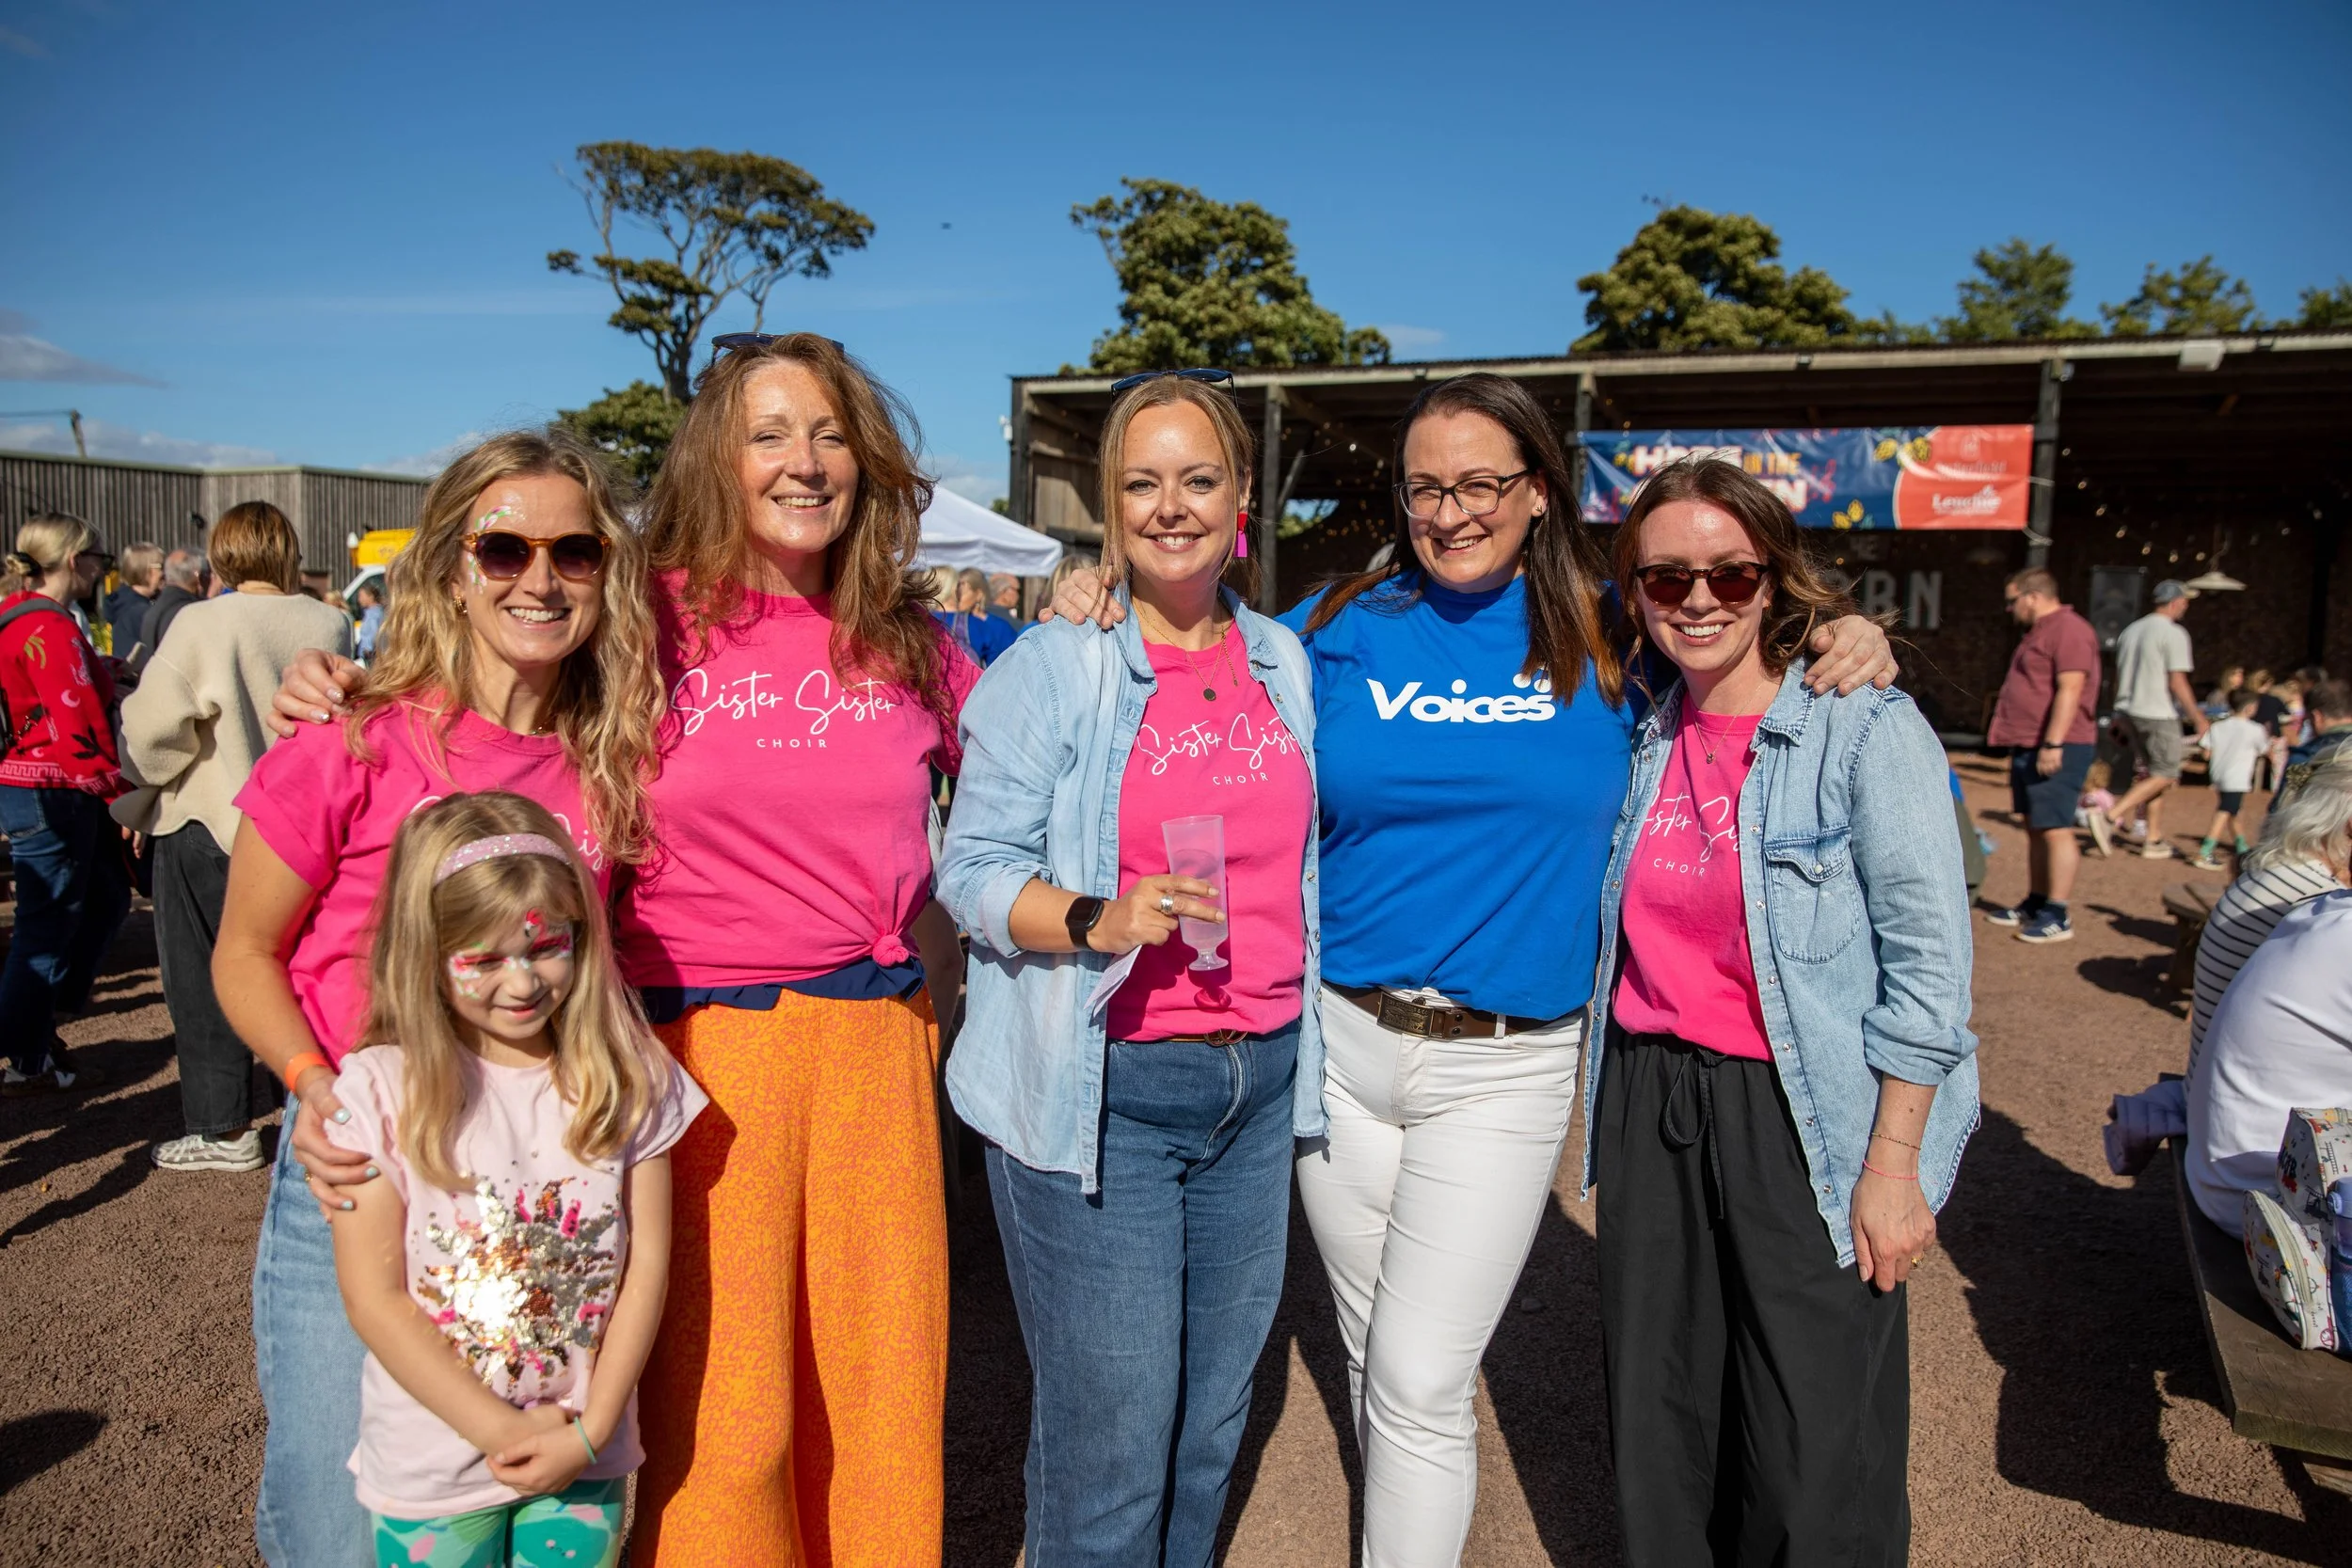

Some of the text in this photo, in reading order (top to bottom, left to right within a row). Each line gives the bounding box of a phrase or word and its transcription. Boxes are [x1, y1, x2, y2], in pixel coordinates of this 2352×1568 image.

[671, 668, 896, 736] Sister Sister
[1366, 674, 1556, 723] Voices
[756, 738, 828, 749] CHOIR
[1136, 720, 1223, 775] Sister
[1213, 772, 1268, 785] CHOIR
[1653, 858, 1706, 877] CHOIR
